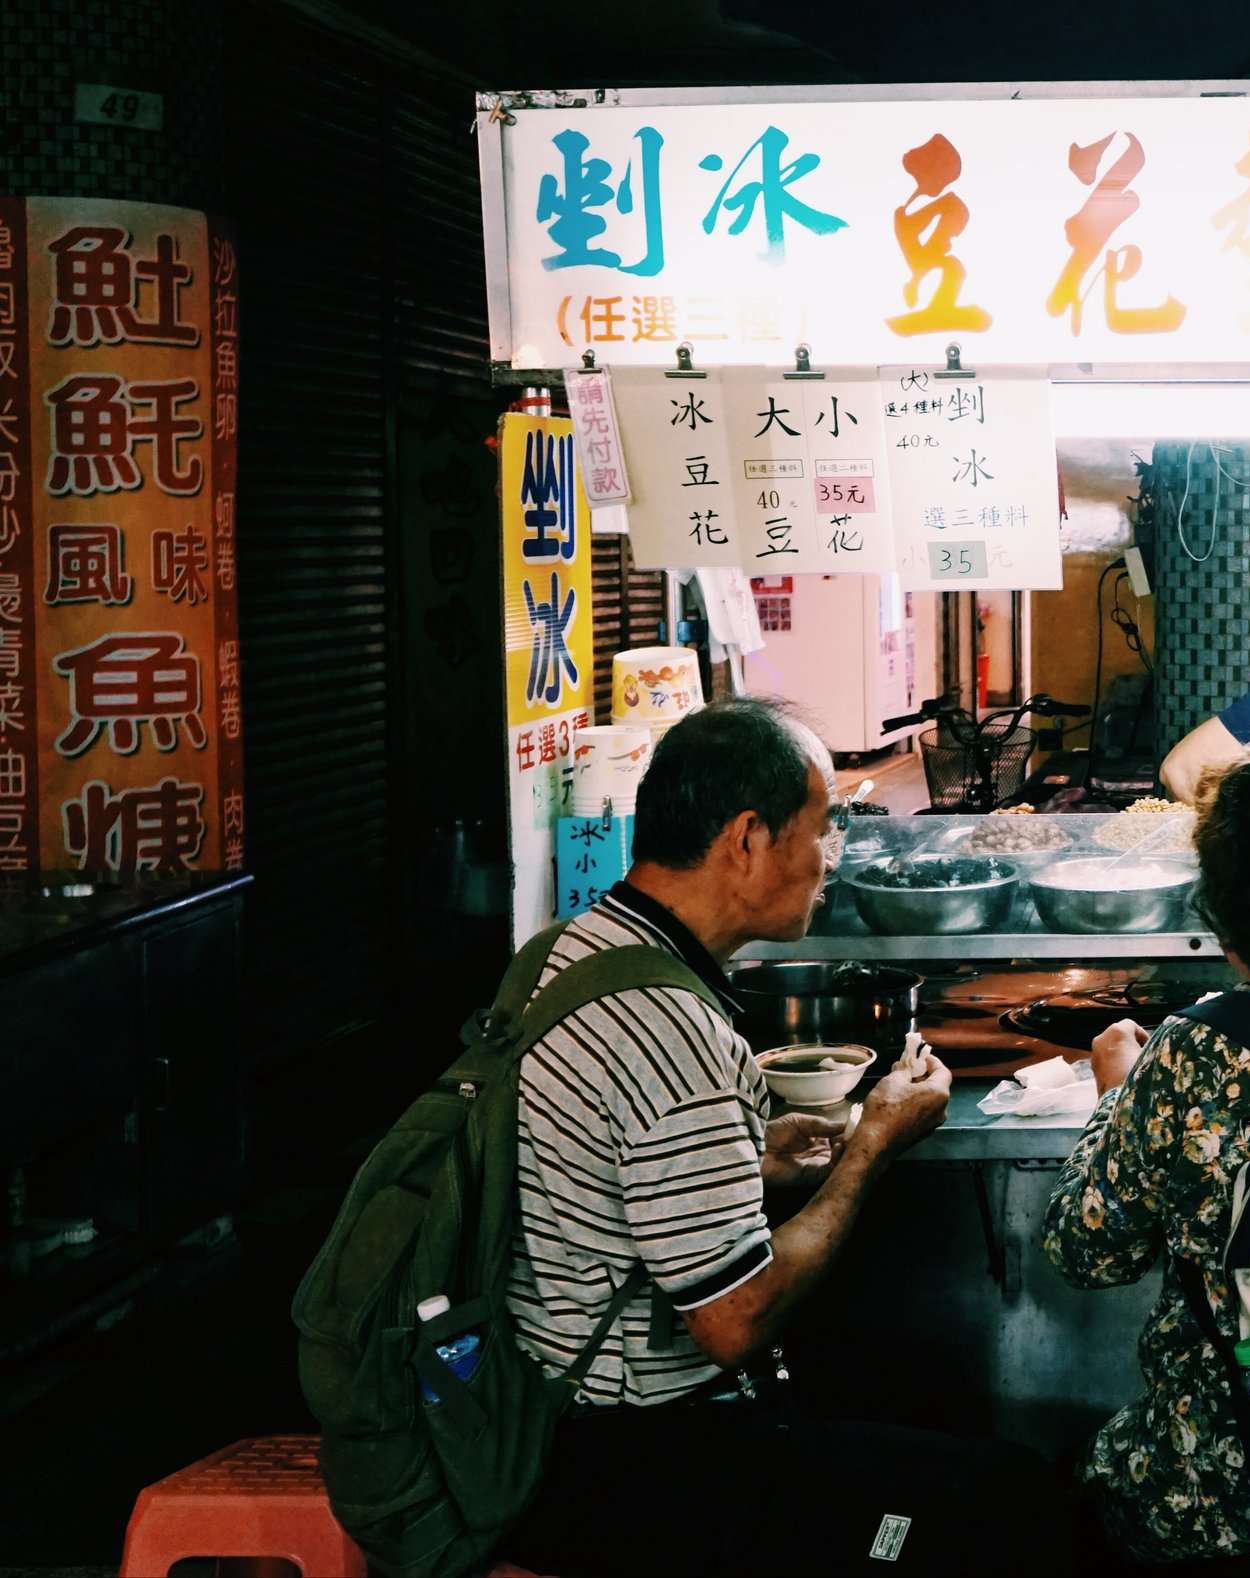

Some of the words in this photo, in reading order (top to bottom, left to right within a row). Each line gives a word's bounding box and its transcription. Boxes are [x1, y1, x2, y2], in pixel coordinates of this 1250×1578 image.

[100, 93, 139, 122] 49
[577, 372, 621, 494] 請先付款
[896, 434, 940, 449] 40元
[670, 392, 729, 546] 冰豆花
[820, 484, 865, 504] 35元
[756, 514, 863, 557] 豆花
[520, 429, 579, 705] 剉冰
[939, 550, 972, 574] 35
